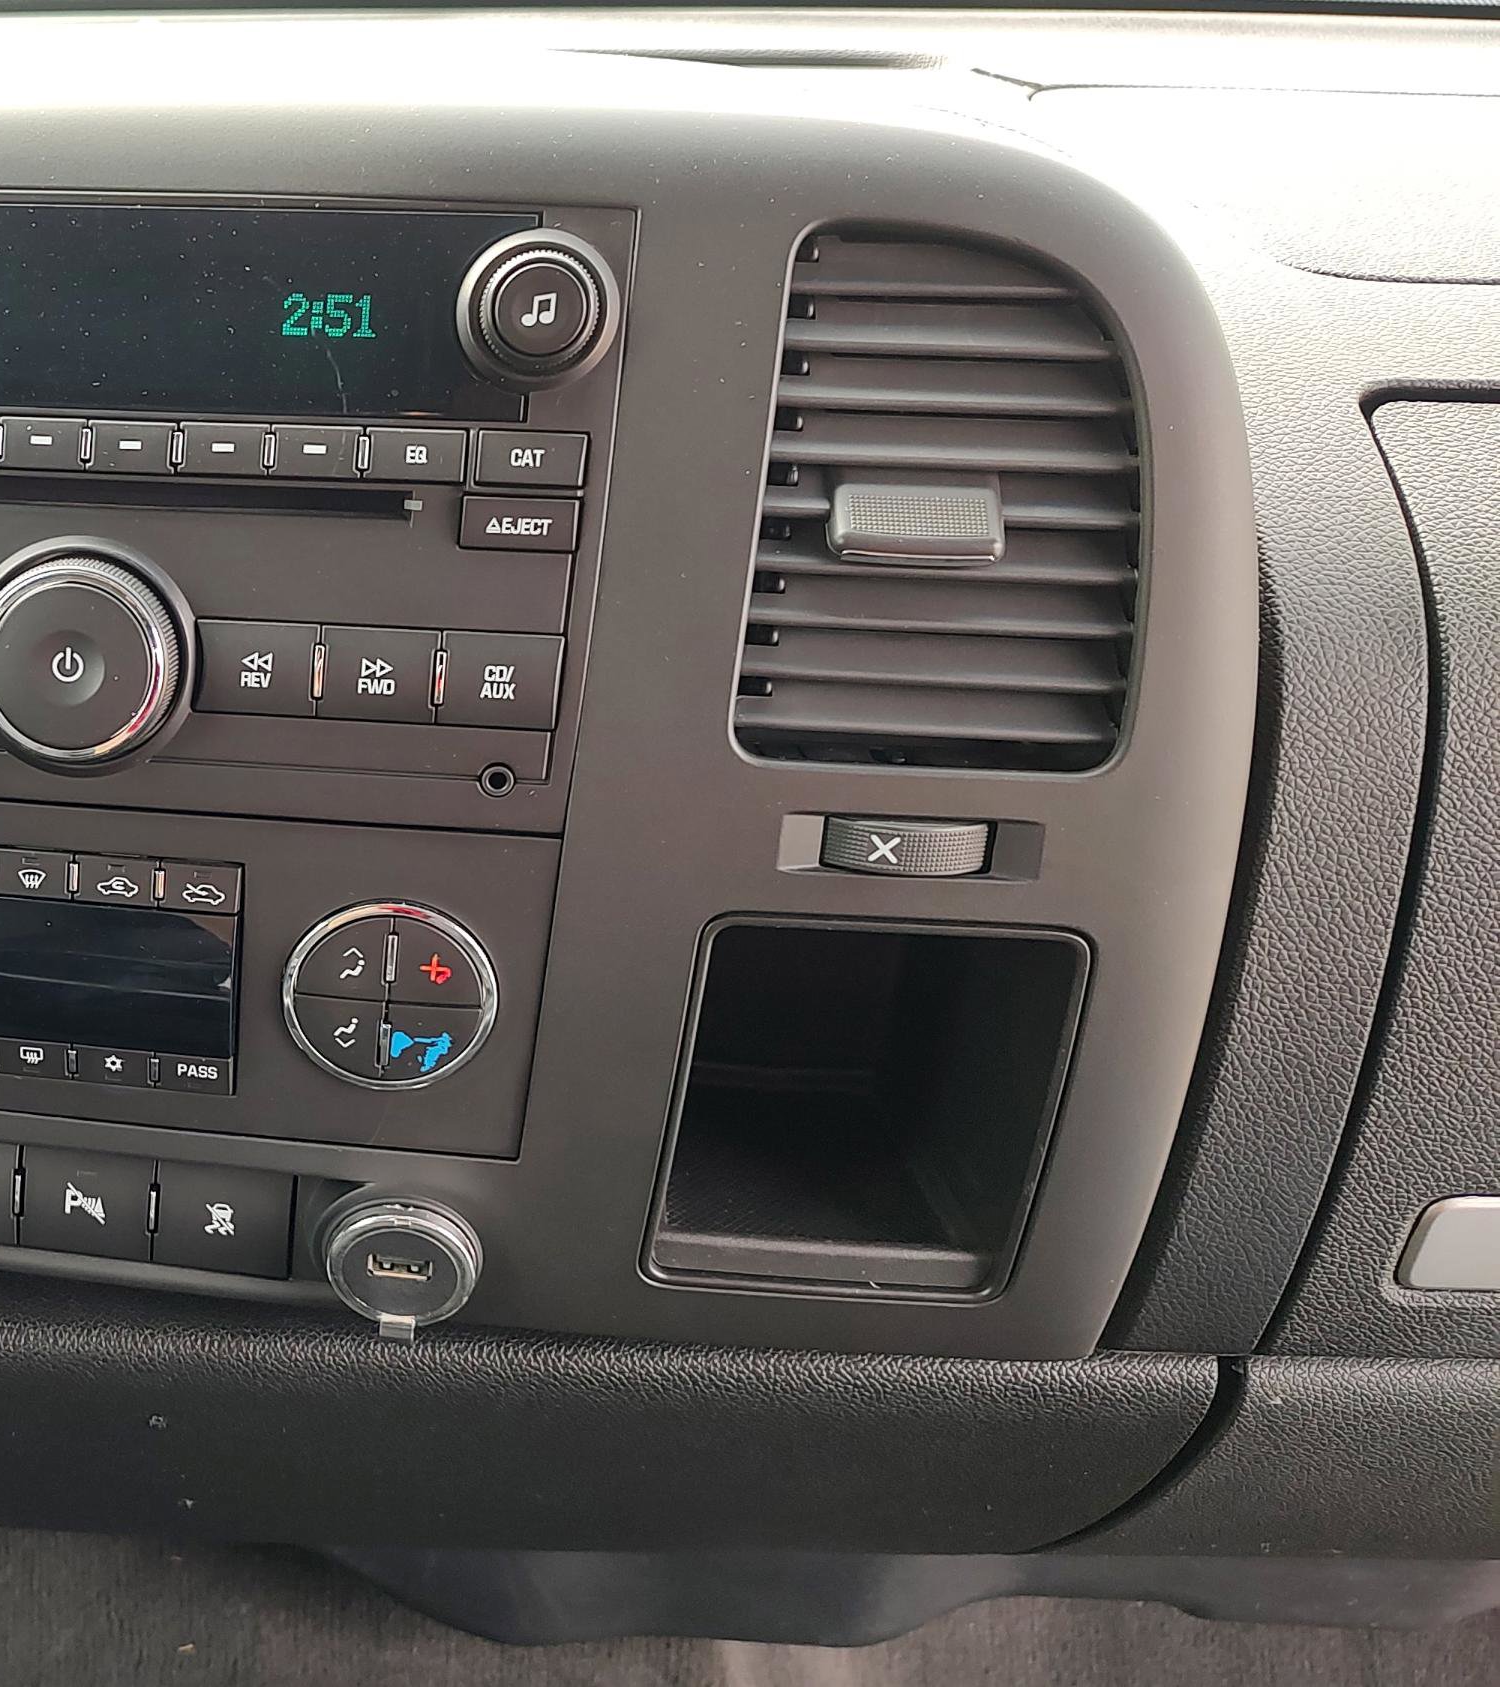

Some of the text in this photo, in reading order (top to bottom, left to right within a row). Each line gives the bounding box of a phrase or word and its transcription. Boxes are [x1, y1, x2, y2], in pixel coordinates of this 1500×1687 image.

[281, 292, 377, 338] 2:51
[405, 445, 428, 465] EQ
[510, 448, 545, 468] CAT
[501, 517, 553, 537] EJECT
[240, 671, 272, 689] REV
[483, 665, 515, 683] CD/
[357, 677, 396, 696] FWD
[479, 681, 517, 700] AUX
[177, 1062, 218, 1080] PASS
